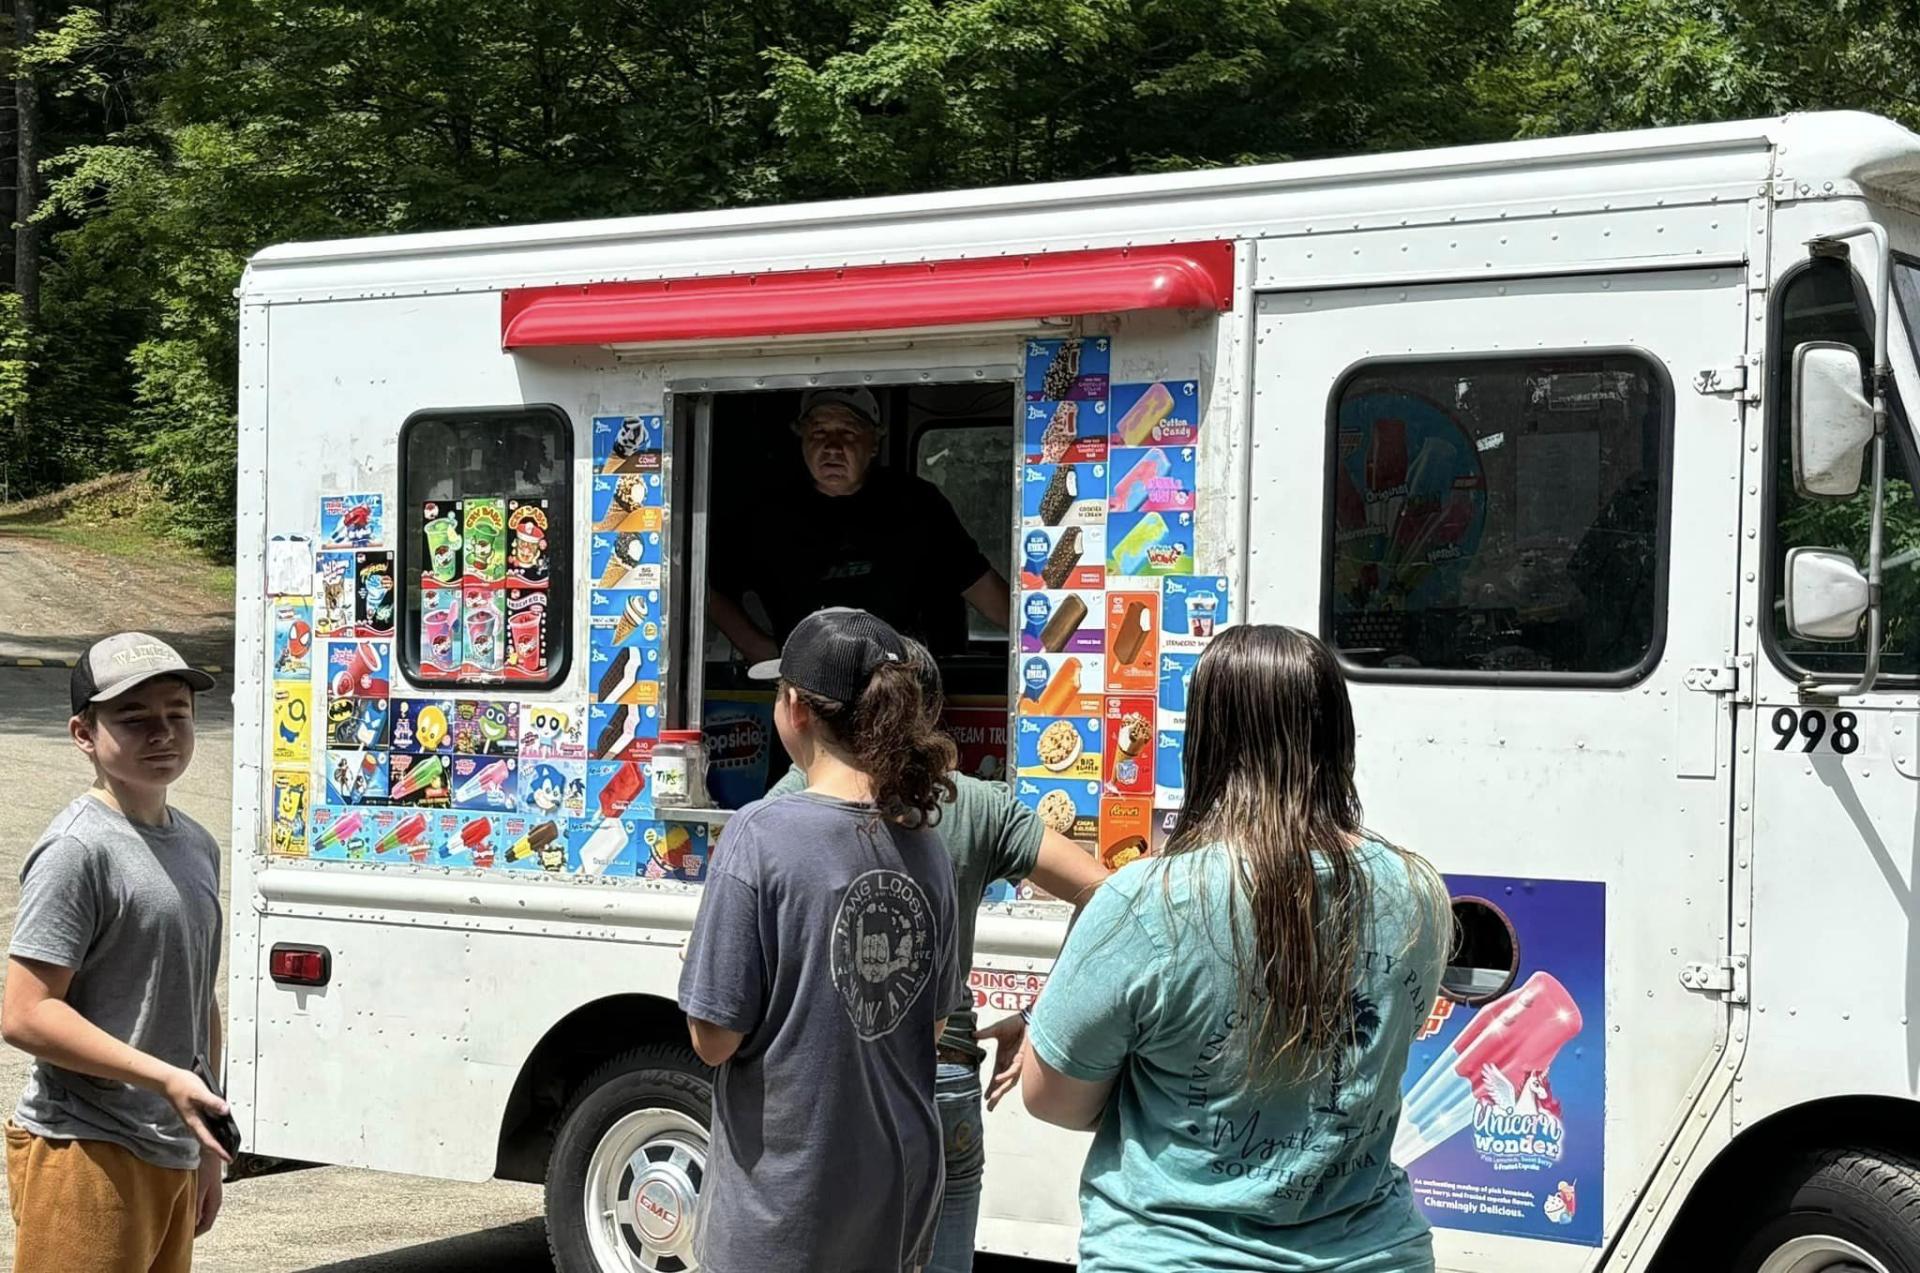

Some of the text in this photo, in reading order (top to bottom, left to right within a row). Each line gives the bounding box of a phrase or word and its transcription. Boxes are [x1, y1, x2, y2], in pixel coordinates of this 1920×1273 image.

[1771, 707, 1859, 755] 998
[878, 874, 926, 929] LOOSE
[1475, 1103, 1561, 1139] Unicorn
[1475, 1134, 1560, 1158] Wonder
[640, 1194, 677, 1225] GMC
[1424, 1197, 1525, 1218] Charmingly Delicious.
